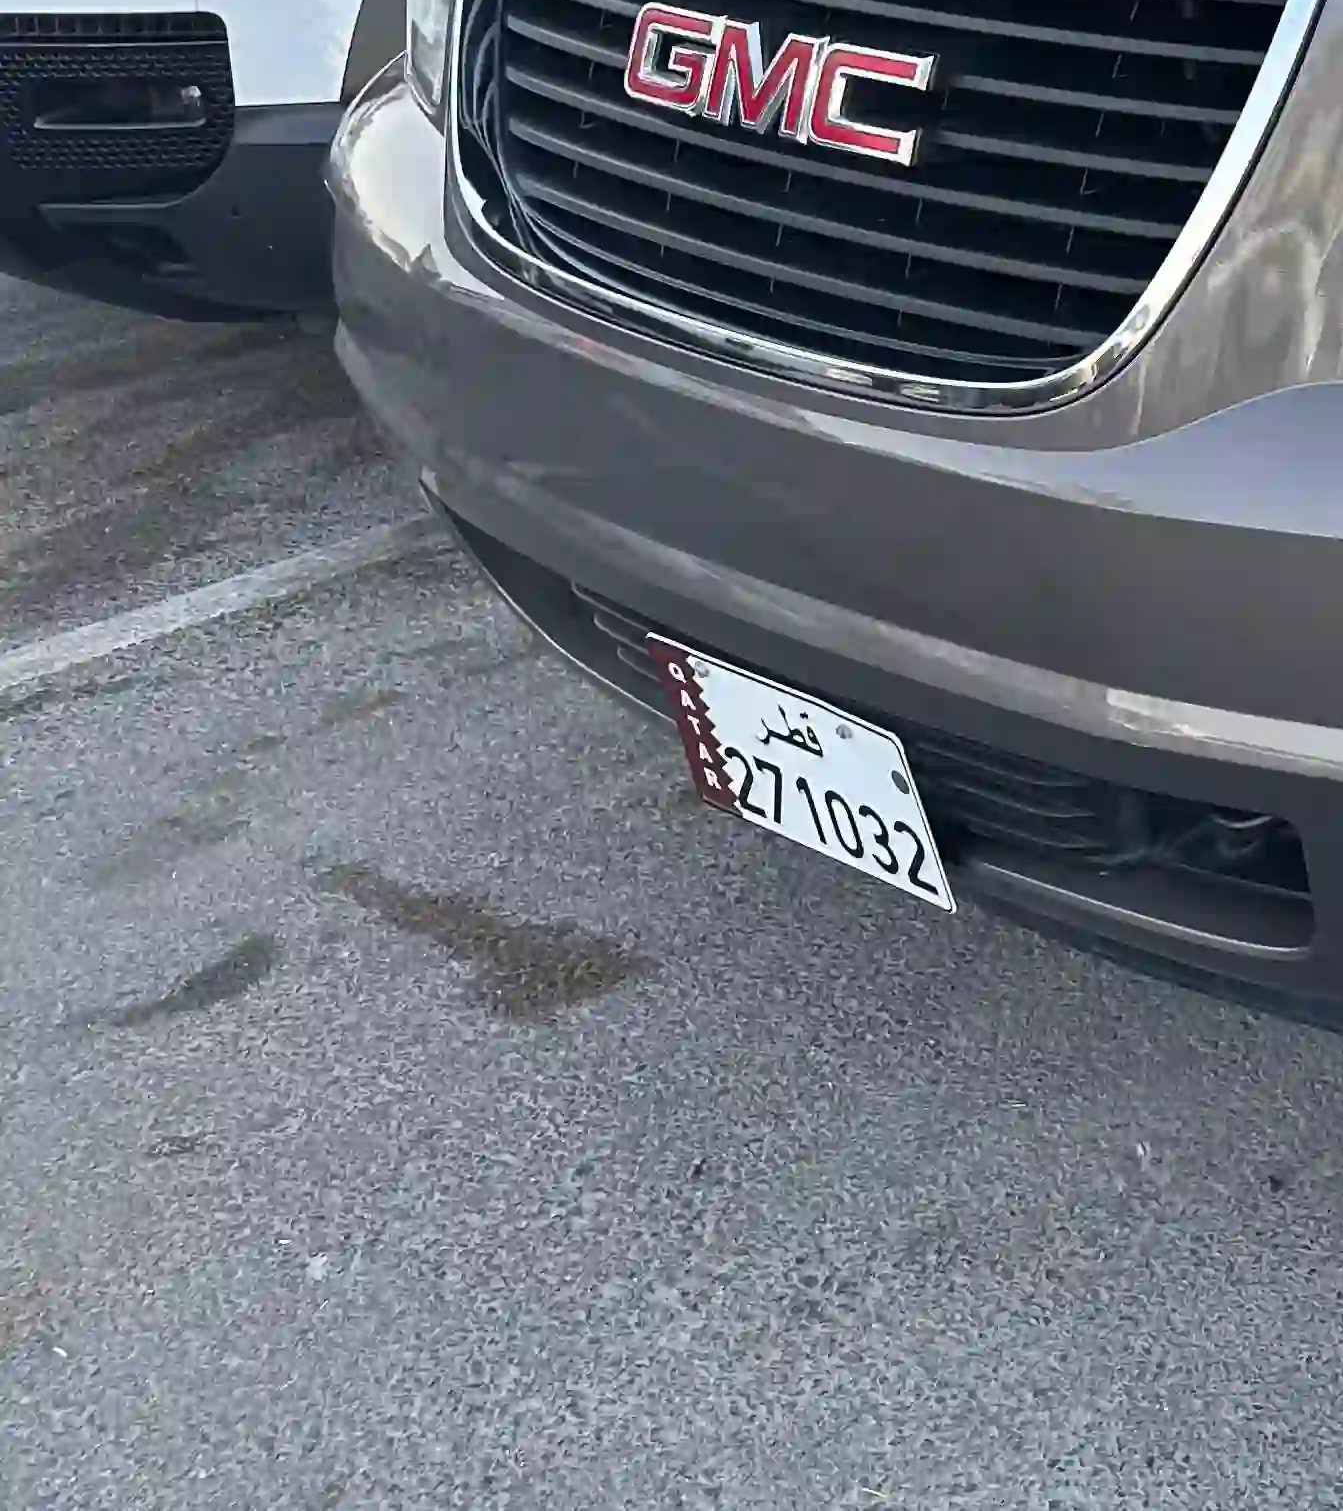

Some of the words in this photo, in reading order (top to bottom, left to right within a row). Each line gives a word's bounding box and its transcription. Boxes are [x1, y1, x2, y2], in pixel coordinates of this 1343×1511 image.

[623, 1, 940, 167] GMC
[667, 661, 722, 790] QATAR
[756, 703, 824, 758] قطر
[724, 746, 940, 896] 271032
